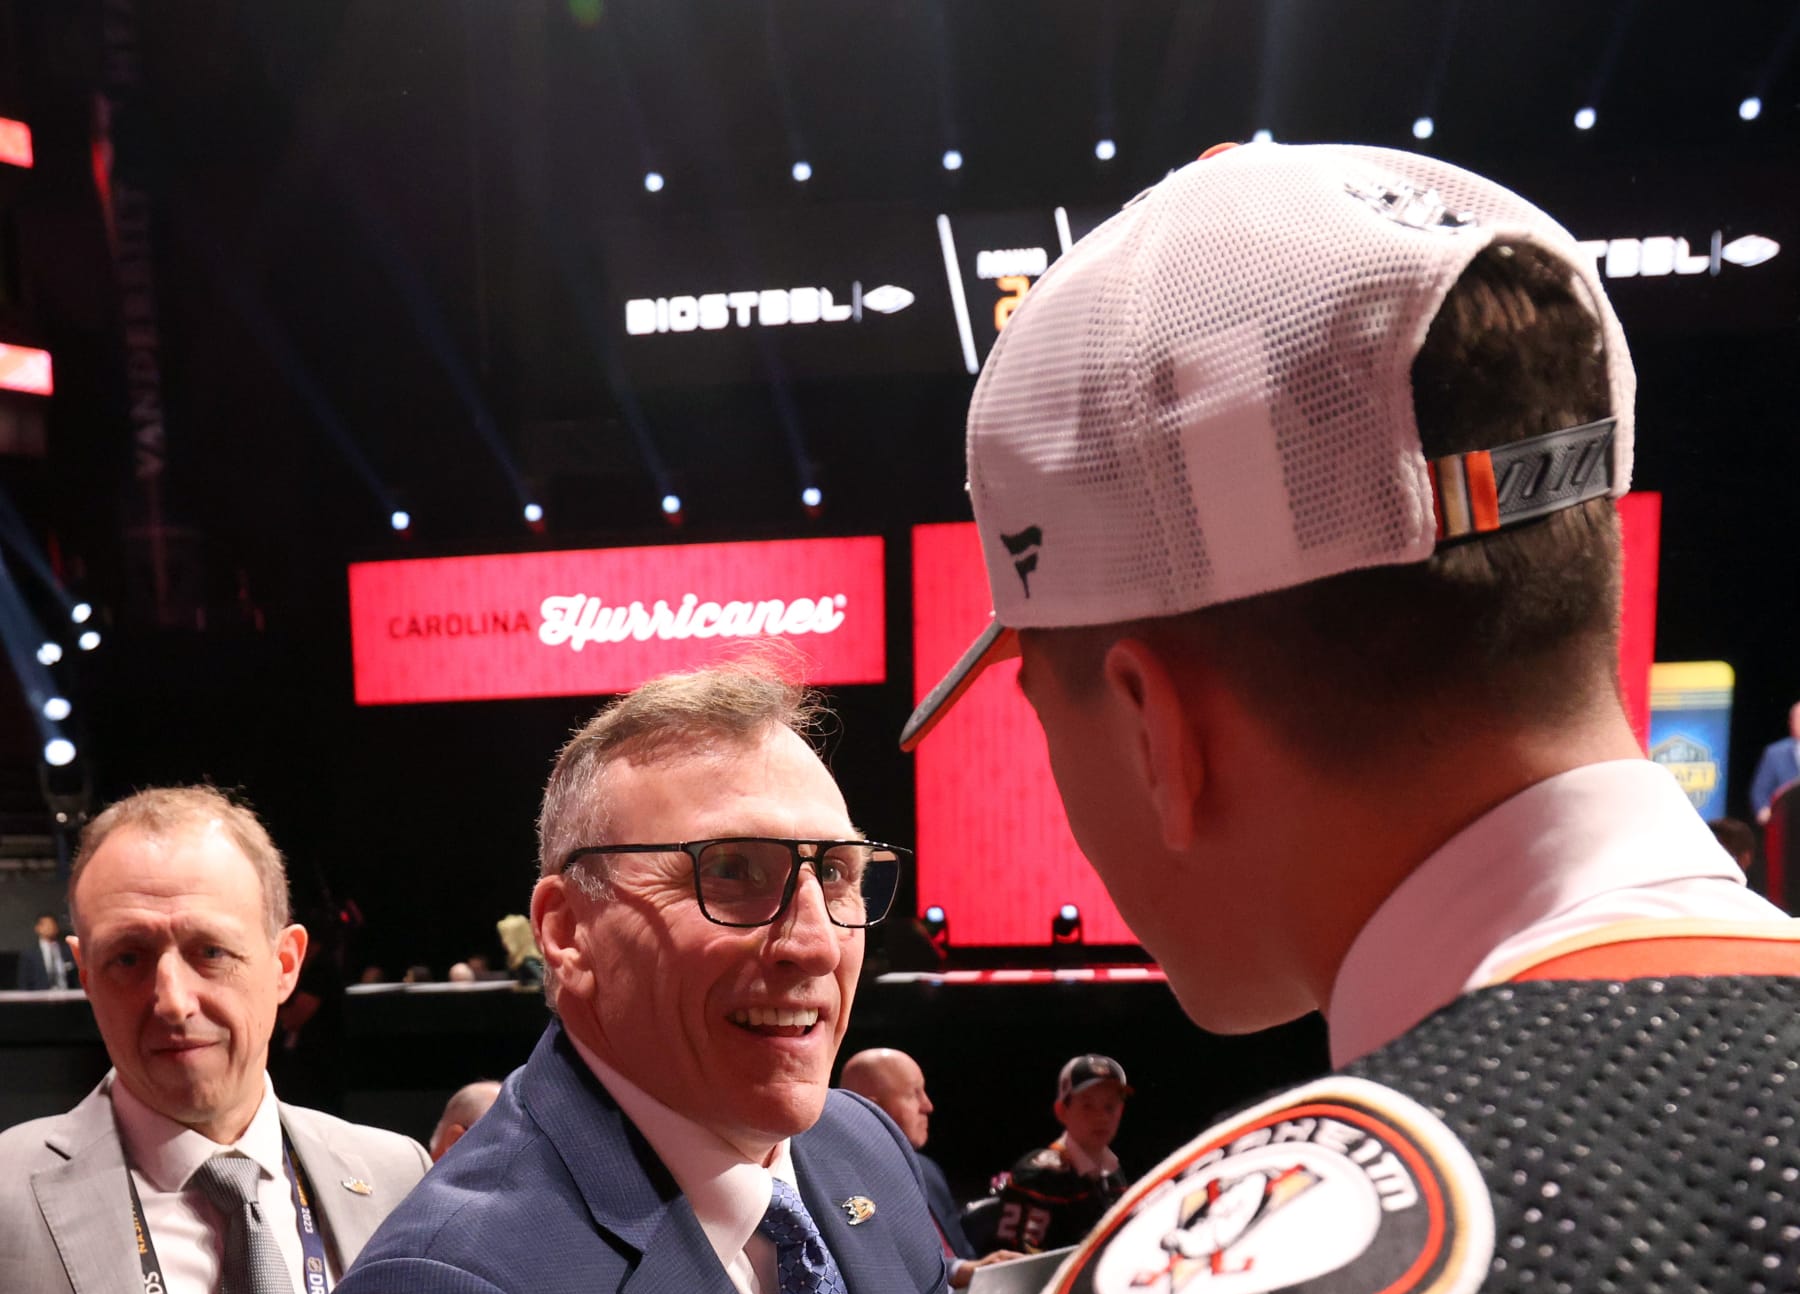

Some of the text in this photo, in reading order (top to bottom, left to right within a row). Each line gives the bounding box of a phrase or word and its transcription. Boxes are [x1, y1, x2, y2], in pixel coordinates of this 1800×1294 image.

[388, 592, 846, 652] CAROLINA Hurricanes
[301, 1207, 314, 1235] 2023
